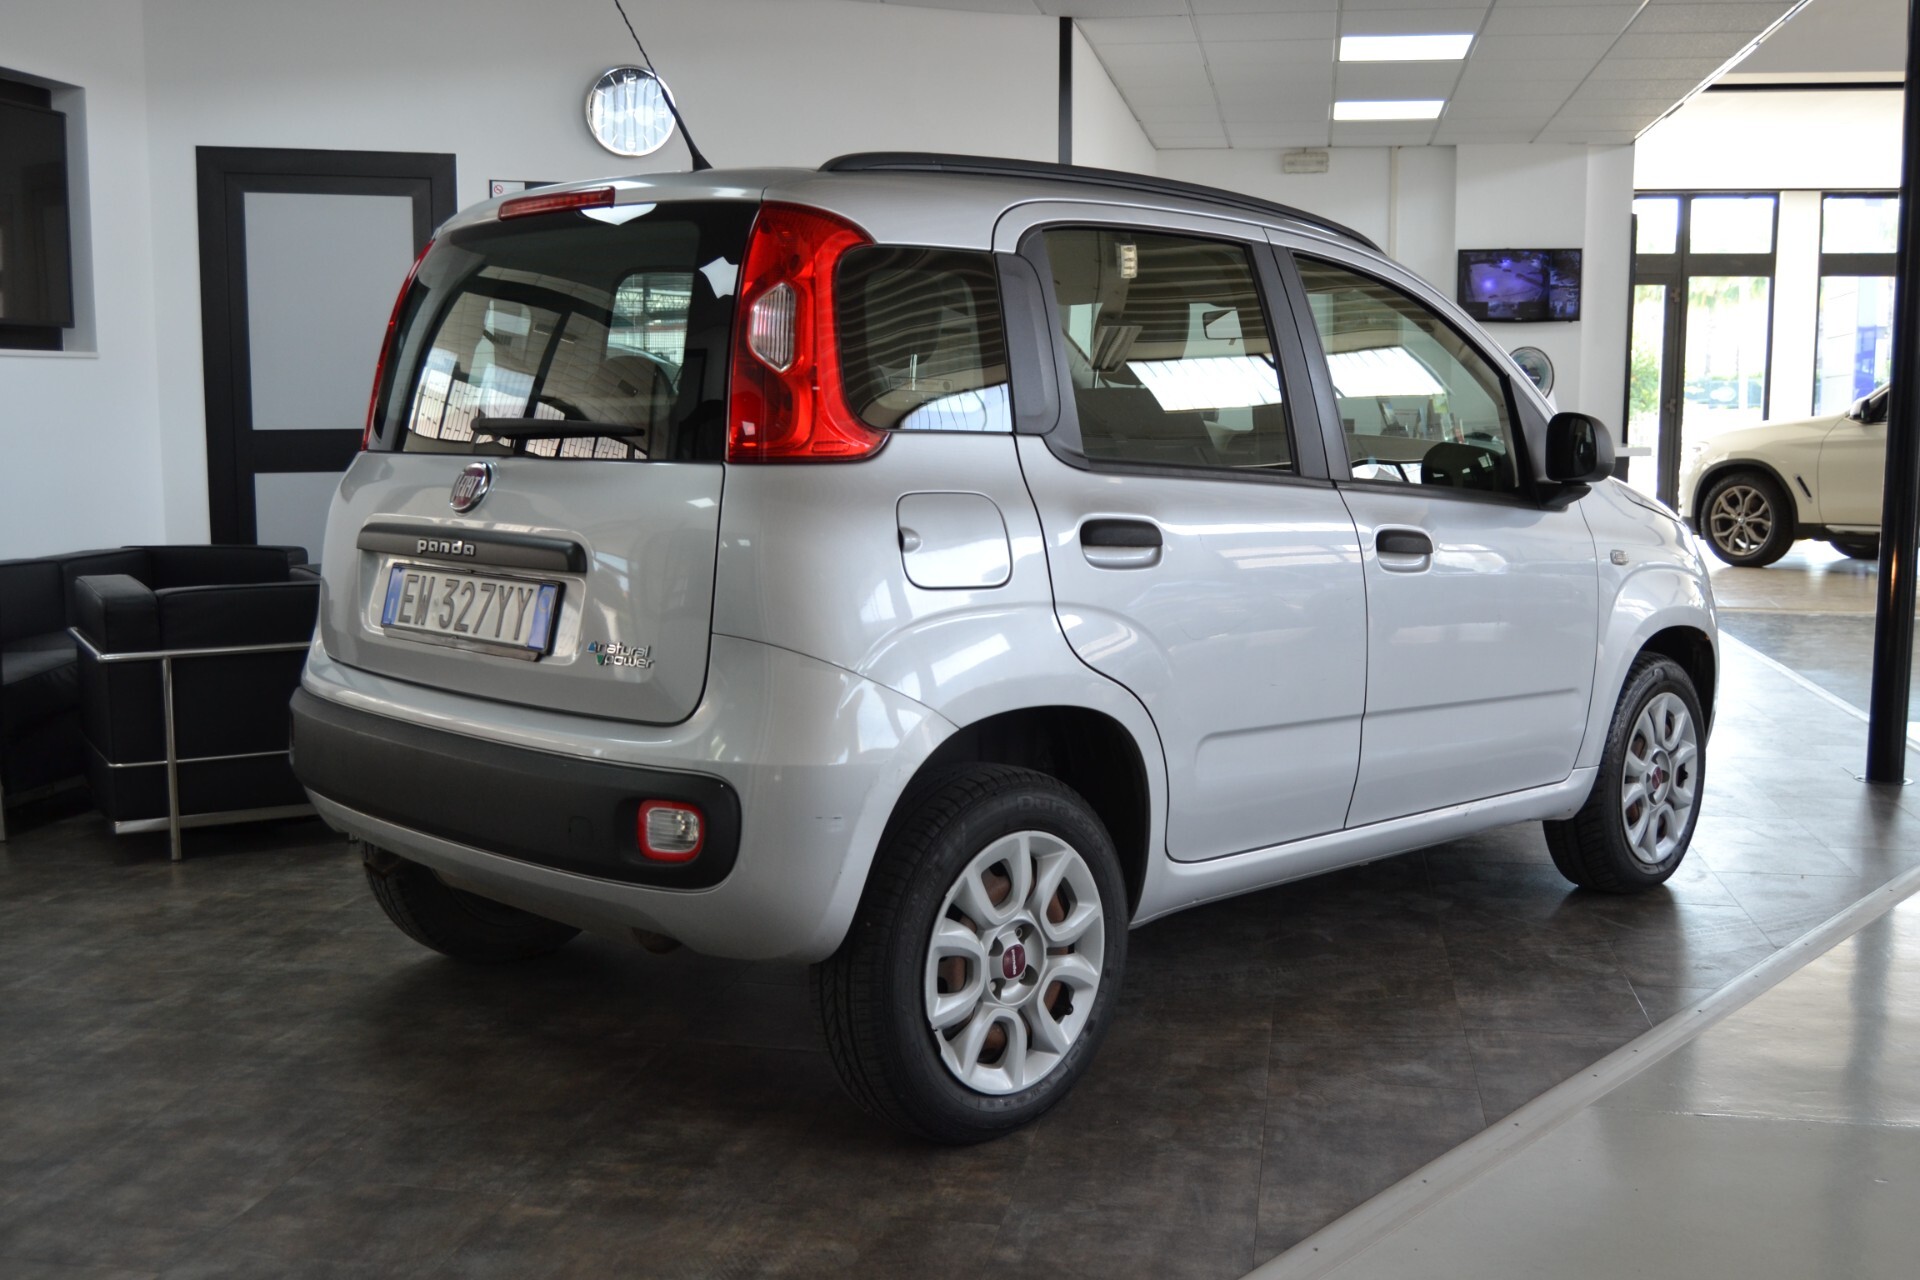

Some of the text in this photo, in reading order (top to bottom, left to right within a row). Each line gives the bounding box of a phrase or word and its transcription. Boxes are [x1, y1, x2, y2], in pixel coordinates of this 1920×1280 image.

[622, 73, 637, 84] 12
[416, 539, 475, 556] panda
[398, 573, 534, 641] EW 327YY
[597, 641, 651, 657] natural
[604, 654, 654, 669] power
